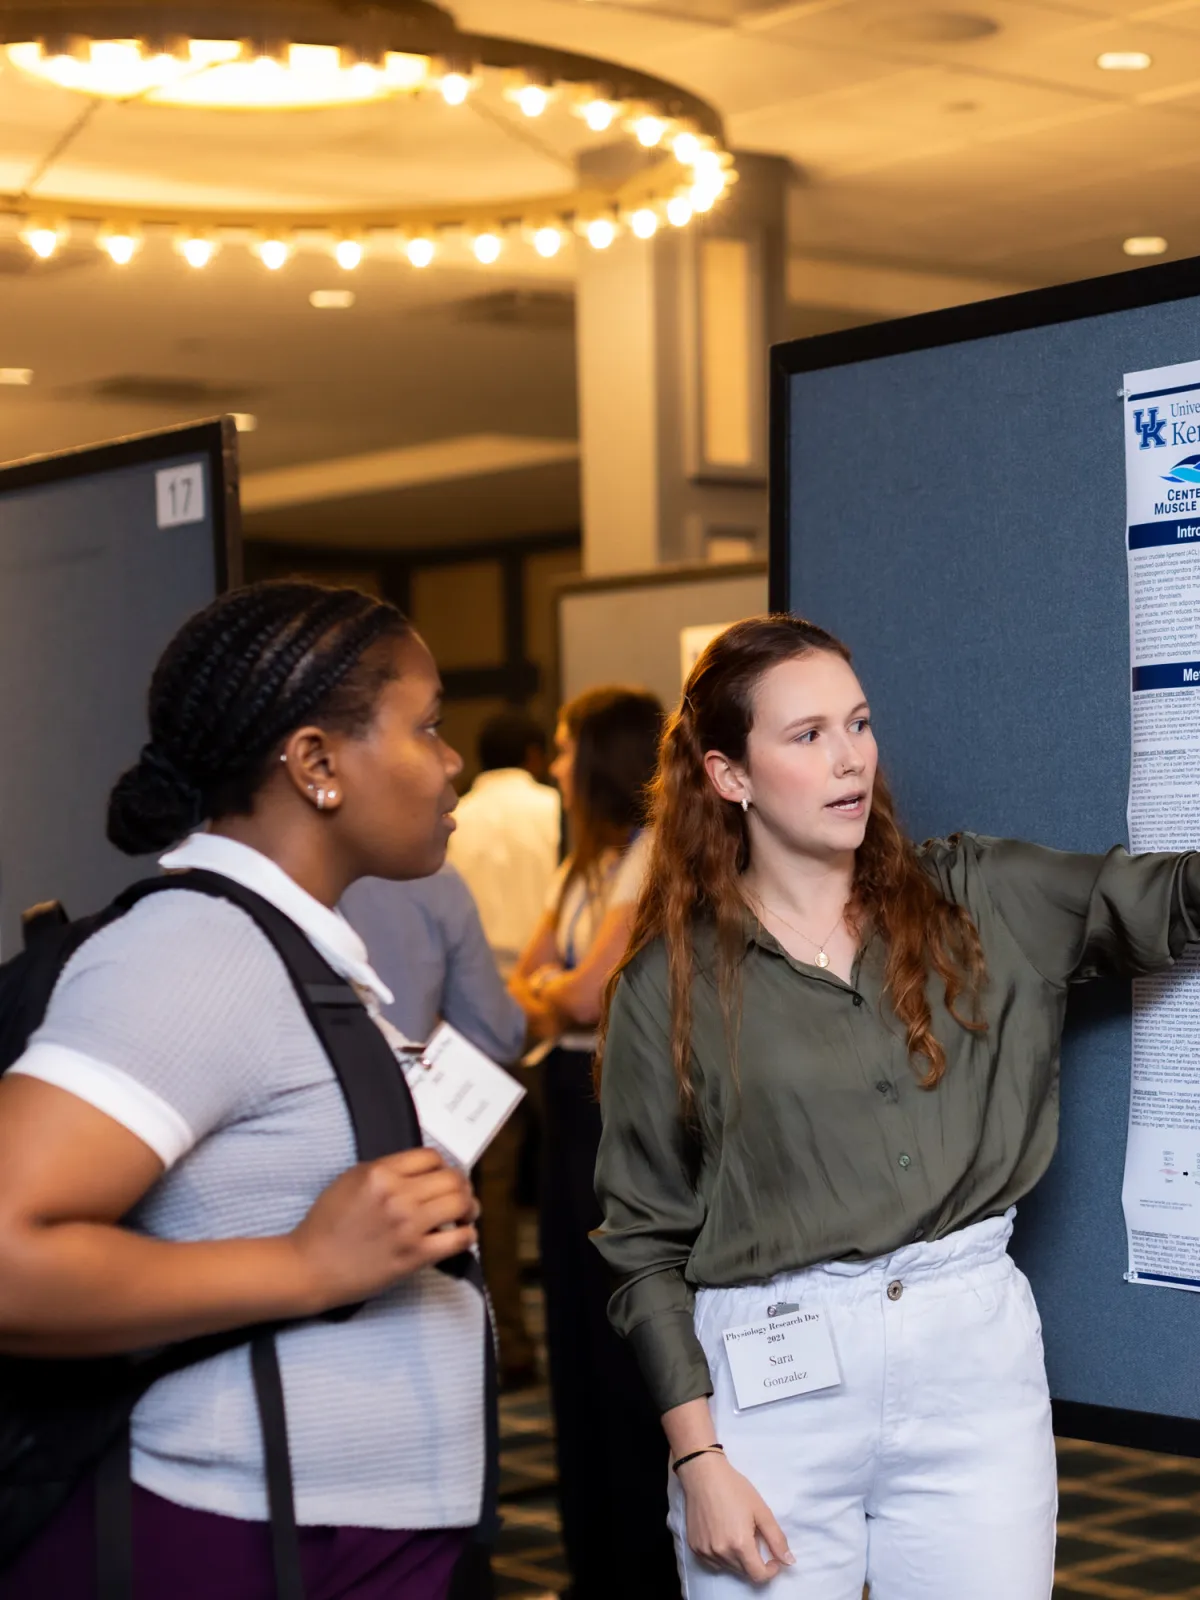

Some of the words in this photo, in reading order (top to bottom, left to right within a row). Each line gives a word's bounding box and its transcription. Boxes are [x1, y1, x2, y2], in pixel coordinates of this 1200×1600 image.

[168, 478, 194, 517] 17
[1155, 501, 1196, 515] MUSCLE
[726, 1326, 767, 1341] Physiology
[769, 1317, 802, 1330] Research
[804, 1313, 820, 1322] Day
[767, 1334, 785, 1343] 2024
[769, 1354, 794, 1366] Sara
[764, 1371, 808, 1388] Gonzalez
